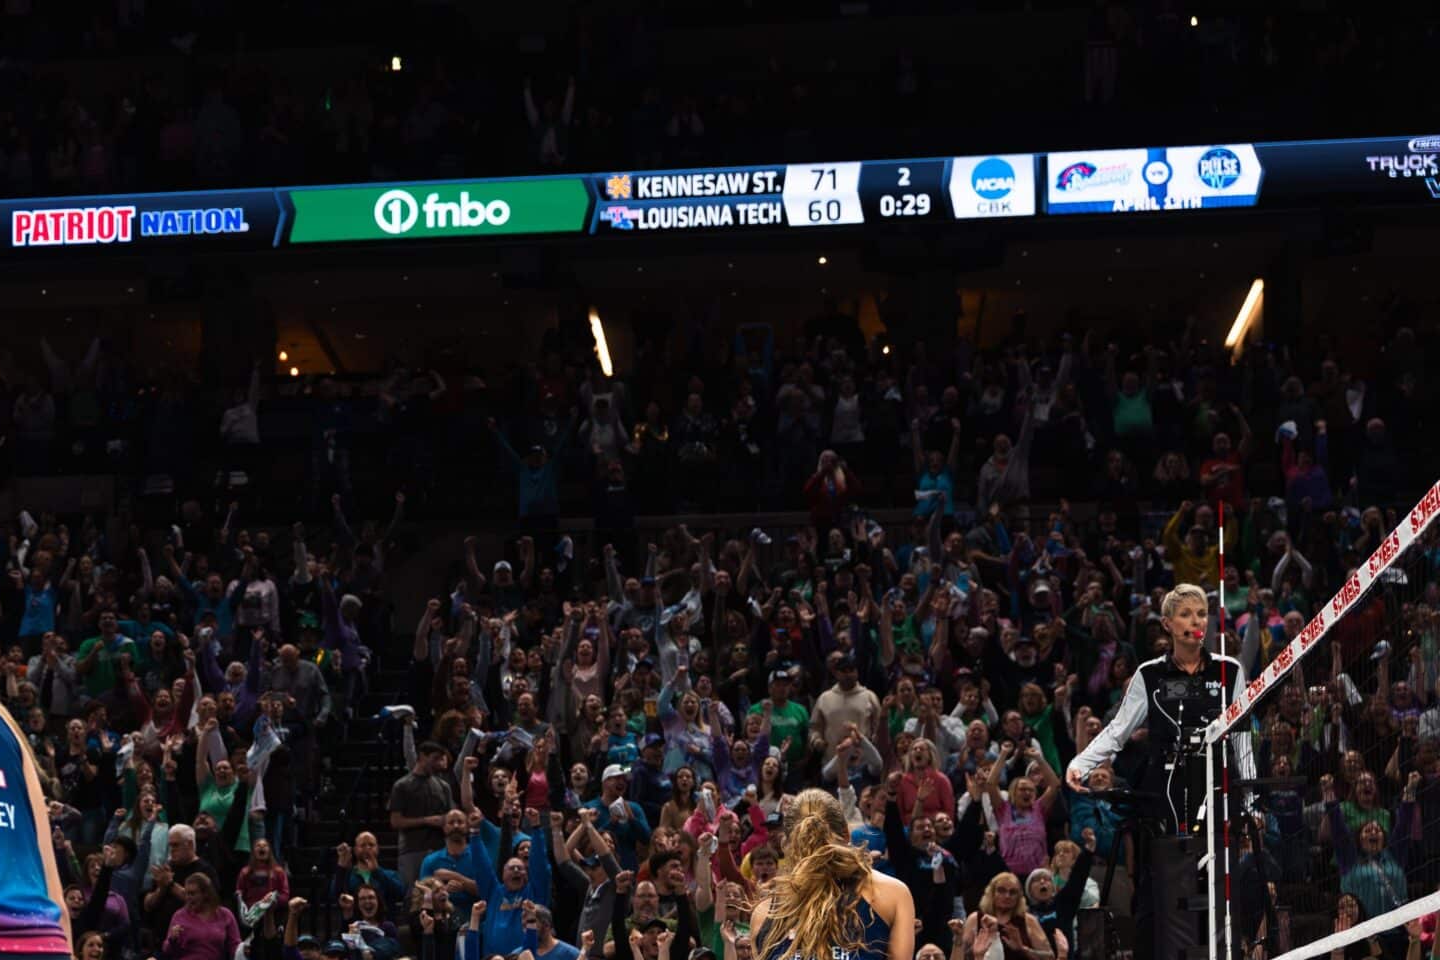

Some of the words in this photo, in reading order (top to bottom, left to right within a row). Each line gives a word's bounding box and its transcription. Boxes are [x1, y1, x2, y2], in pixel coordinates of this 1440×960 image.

[637, 175, 753, 198] KENNESAW
[753, 171, 782, 194] ST.
[811, 168, 838, 191] 71
[897, 168, 911, 187] 2
[424, 190, 511, 229] fnbo
[637, 203, 734, 230] LOUISIANA
[735, 201, 782, 225] TECH
[808, 200, 841, 222] 60
[879, 193, 931, 217] 0:29
[976, 199, 1013, 215] CBK
[12, 206, 136, 247] PATRIOT
